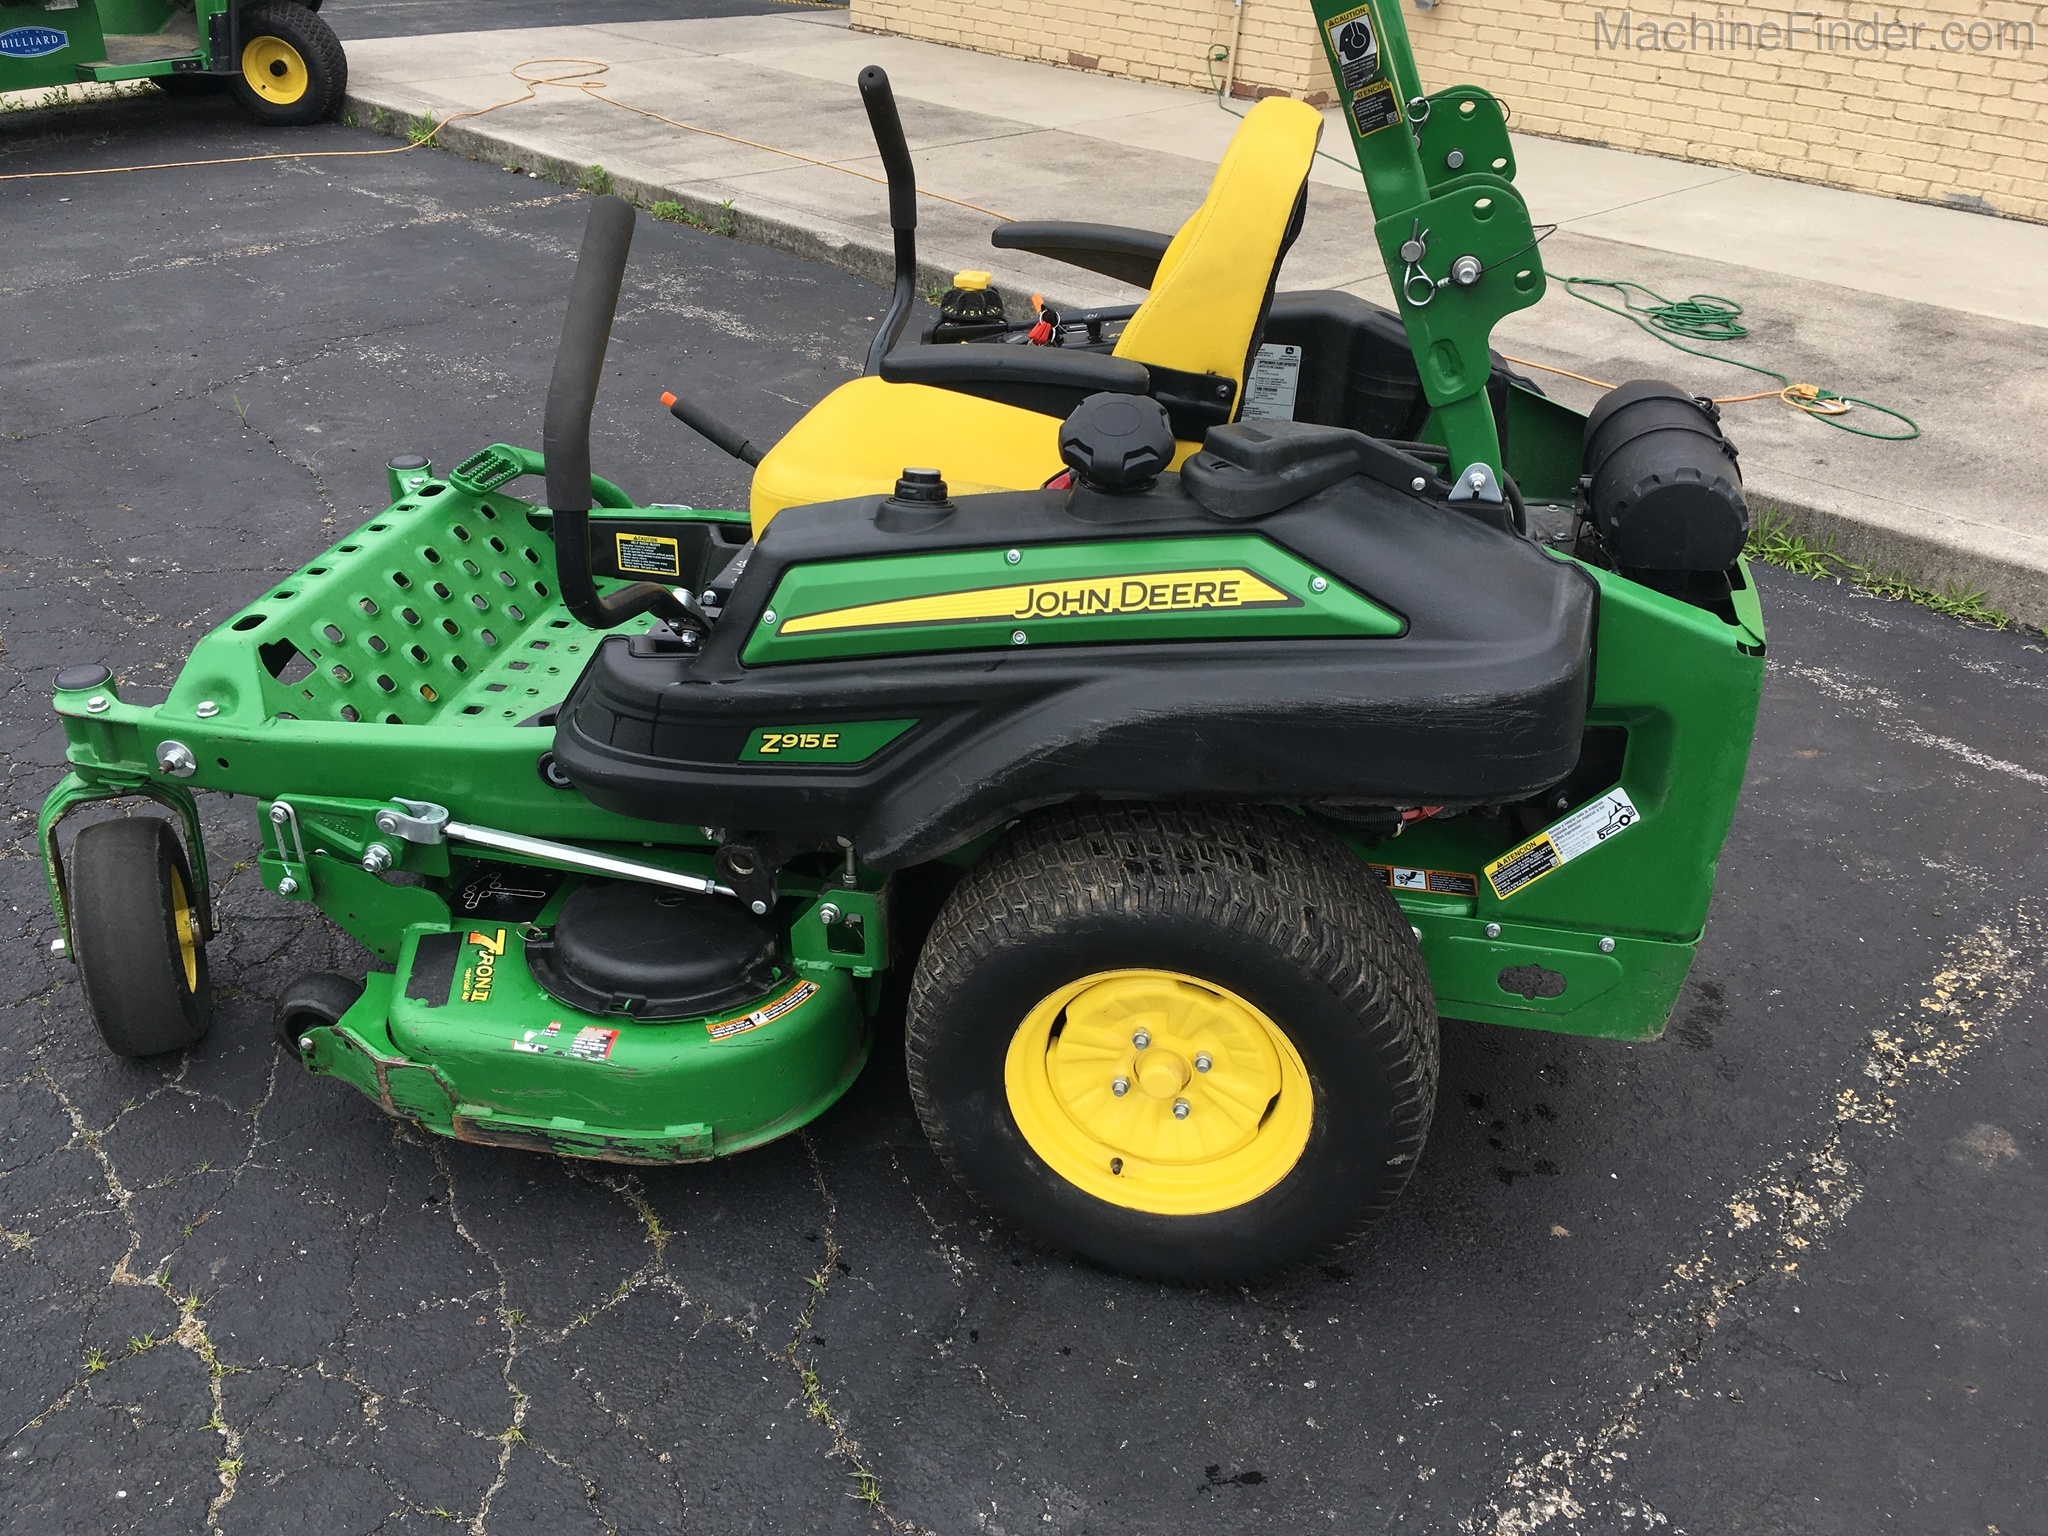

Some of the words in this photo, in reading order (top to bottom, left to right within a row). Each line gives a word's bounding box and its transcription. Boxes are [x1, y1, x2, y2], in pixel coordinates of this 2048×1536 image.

[1334, 7, 1366, 25] CAUTION
[1, 34, 59, 49] HILLIARD
[1014, 587, 1112, 615] JOHN
[1120, 580, 1241, 608] DEERE
[759, 733, 840, 753] Z915E
